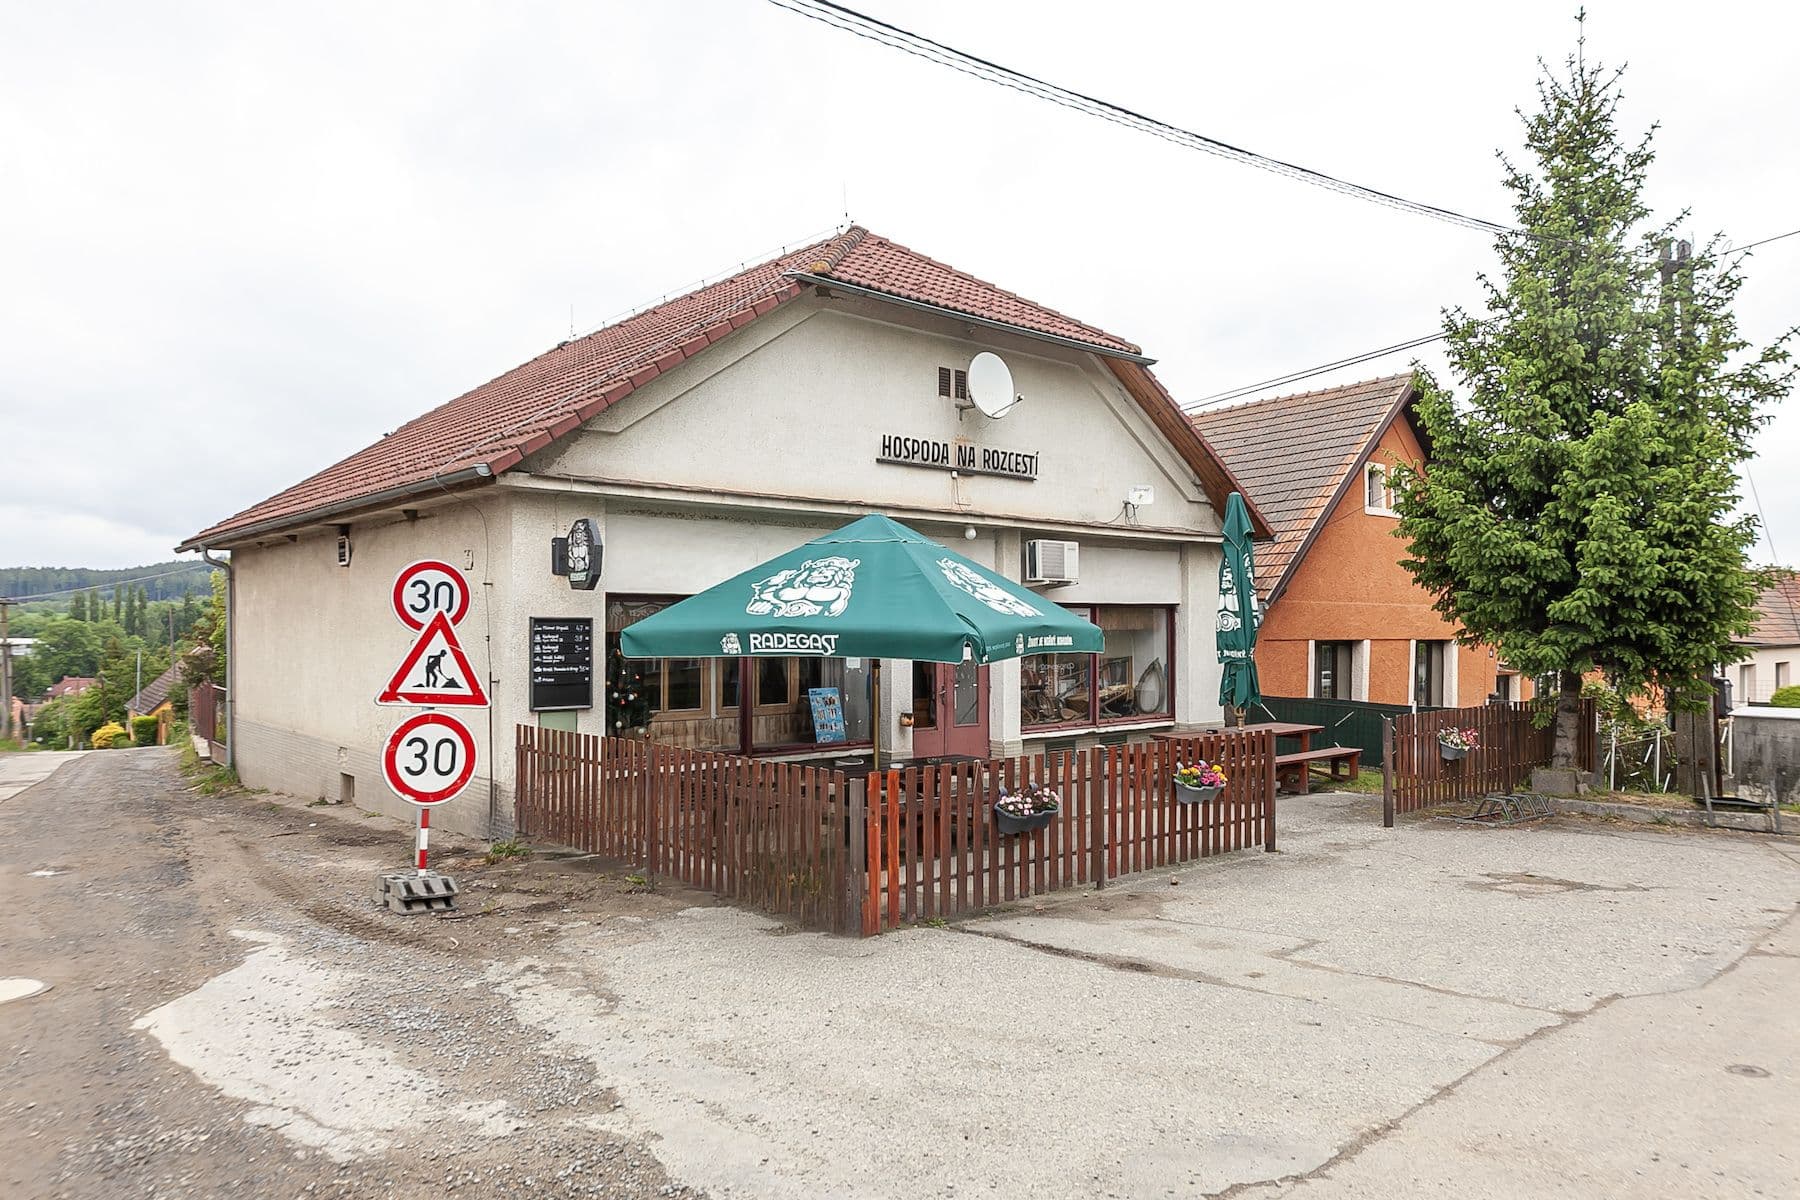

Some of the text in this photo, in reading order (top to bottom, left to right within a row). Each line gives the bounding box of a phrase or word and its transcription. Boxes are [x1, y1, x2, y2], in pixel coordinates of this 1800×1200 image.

[882, 434, 1039, 475] HOSPODA NA ROZCESTÍ
[409, 579, 454, 614] 30
[749, 633, 839, 656] RADEGAST
[404, 737, 457, 777] 30
